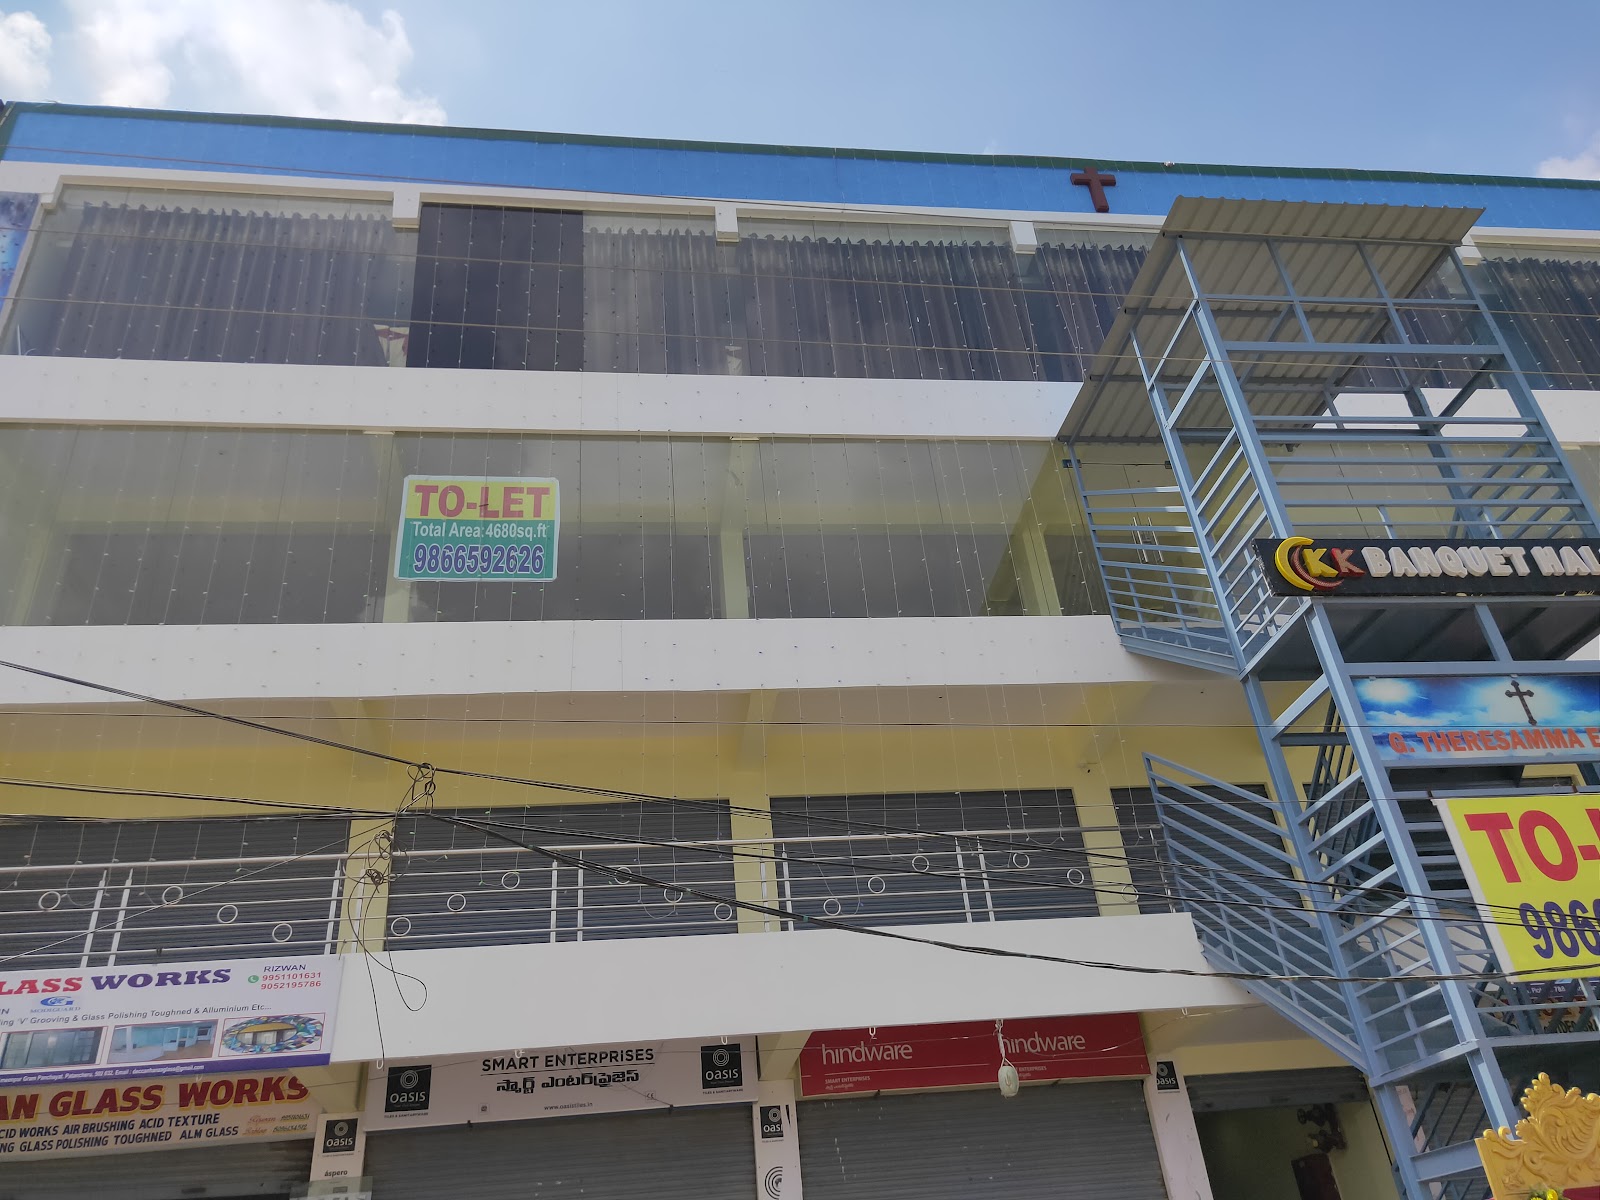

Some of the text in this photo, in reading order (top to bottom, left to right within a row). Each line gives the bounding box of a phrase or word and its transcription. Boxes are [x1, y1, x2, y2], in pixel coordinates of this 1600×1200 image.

[414, 484, 550, 518] TO-LET
[412, 521, 446, 537] Total
[413, 543, 545, 574] 9866592626
[1362, 546, 1531, 579] BANQUET
[1388, 732, 1415, 754] G.
[1418, 728, 1585, 753] THERESAMMA
[1518, 898, 1600, 959] 986
[91, 968, 231, 990] WORKS
[262, 972, 321, 982] 9951101631
[263, 964, 307, 973] RIZWAN
[261, 980, 321, 990] 9052195786
[30, 1015, 70, 1025] Grooving
[108, 1011, 148, 1020] Polishing
[150, 1008, 192, 1017] Toughned
[202, 1005, 249, 1014] Alluminium
[482, 1056, 539, 1072] SMART
[821, 1041, 913, 1065] hindware
[705, 1068, 739, 1081] oasis
[49, 1085, 164, 1118] GLASS
[179, 1075, 309, 1108] WORKS
[389, 1091, 426, 1104] oasis
[19, 1125, 59, 1138] WORKS
[62, 1124, 80, 1135] AIR
[82, 1119, 136, 1134] BRUSHING
[139, 1116, 165, 1130] ACID
[168, 1113, 220, 1127] TEXTURE
[19, 1139, 53, 1152] GLASS
[55, 1136, 109, 1150] POLISHING
[114, 1131, 172, 1145] TOUGHNED
[179, 1128, 201, 1140] ALM
[205, 1126, 239, 1138] GLASS
[326, 1137, 353, 1147] oasis
